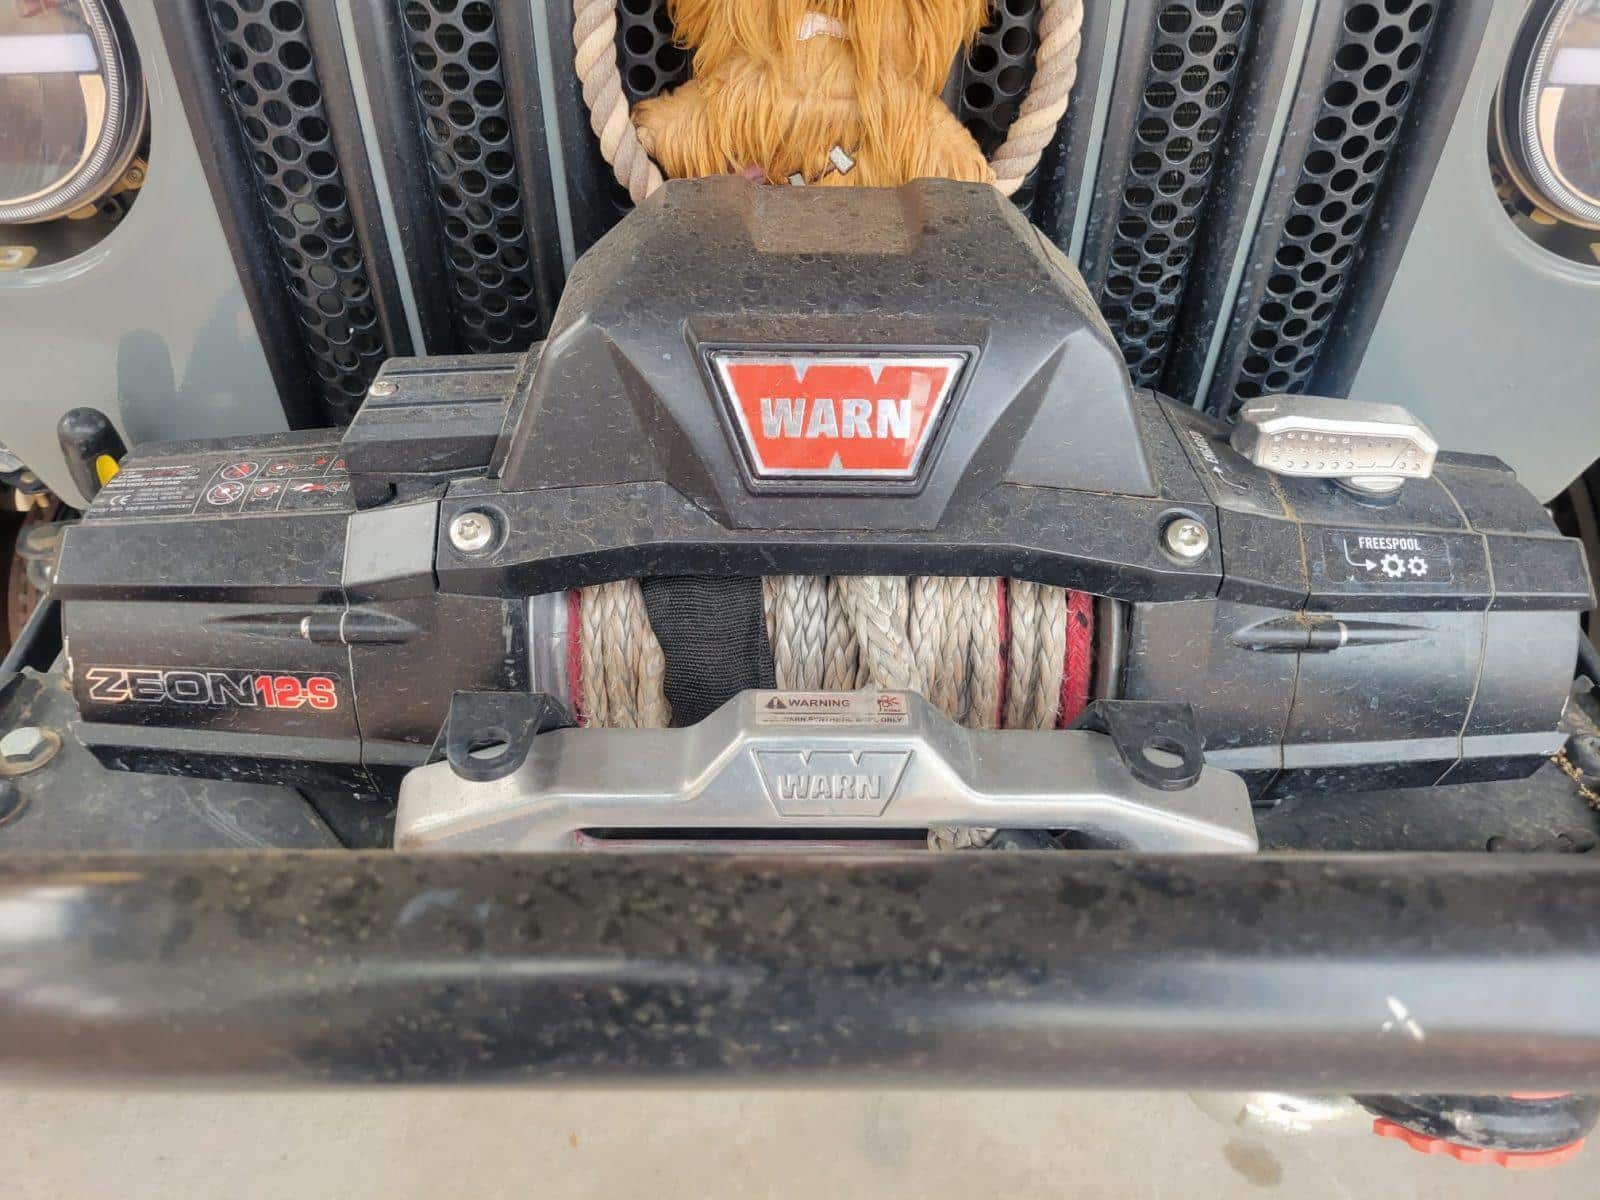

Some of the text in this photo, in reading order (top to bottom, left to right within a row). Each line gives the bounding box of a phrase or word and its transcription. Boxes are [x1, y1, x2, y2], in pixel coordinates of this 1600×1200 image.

[760, 397, 912, 440] WARN
[1358, 536, 1421, 551] FREESPOOL
[788, 699, 850, 708] WARNING
[777, 773, 881, 800] WARN
